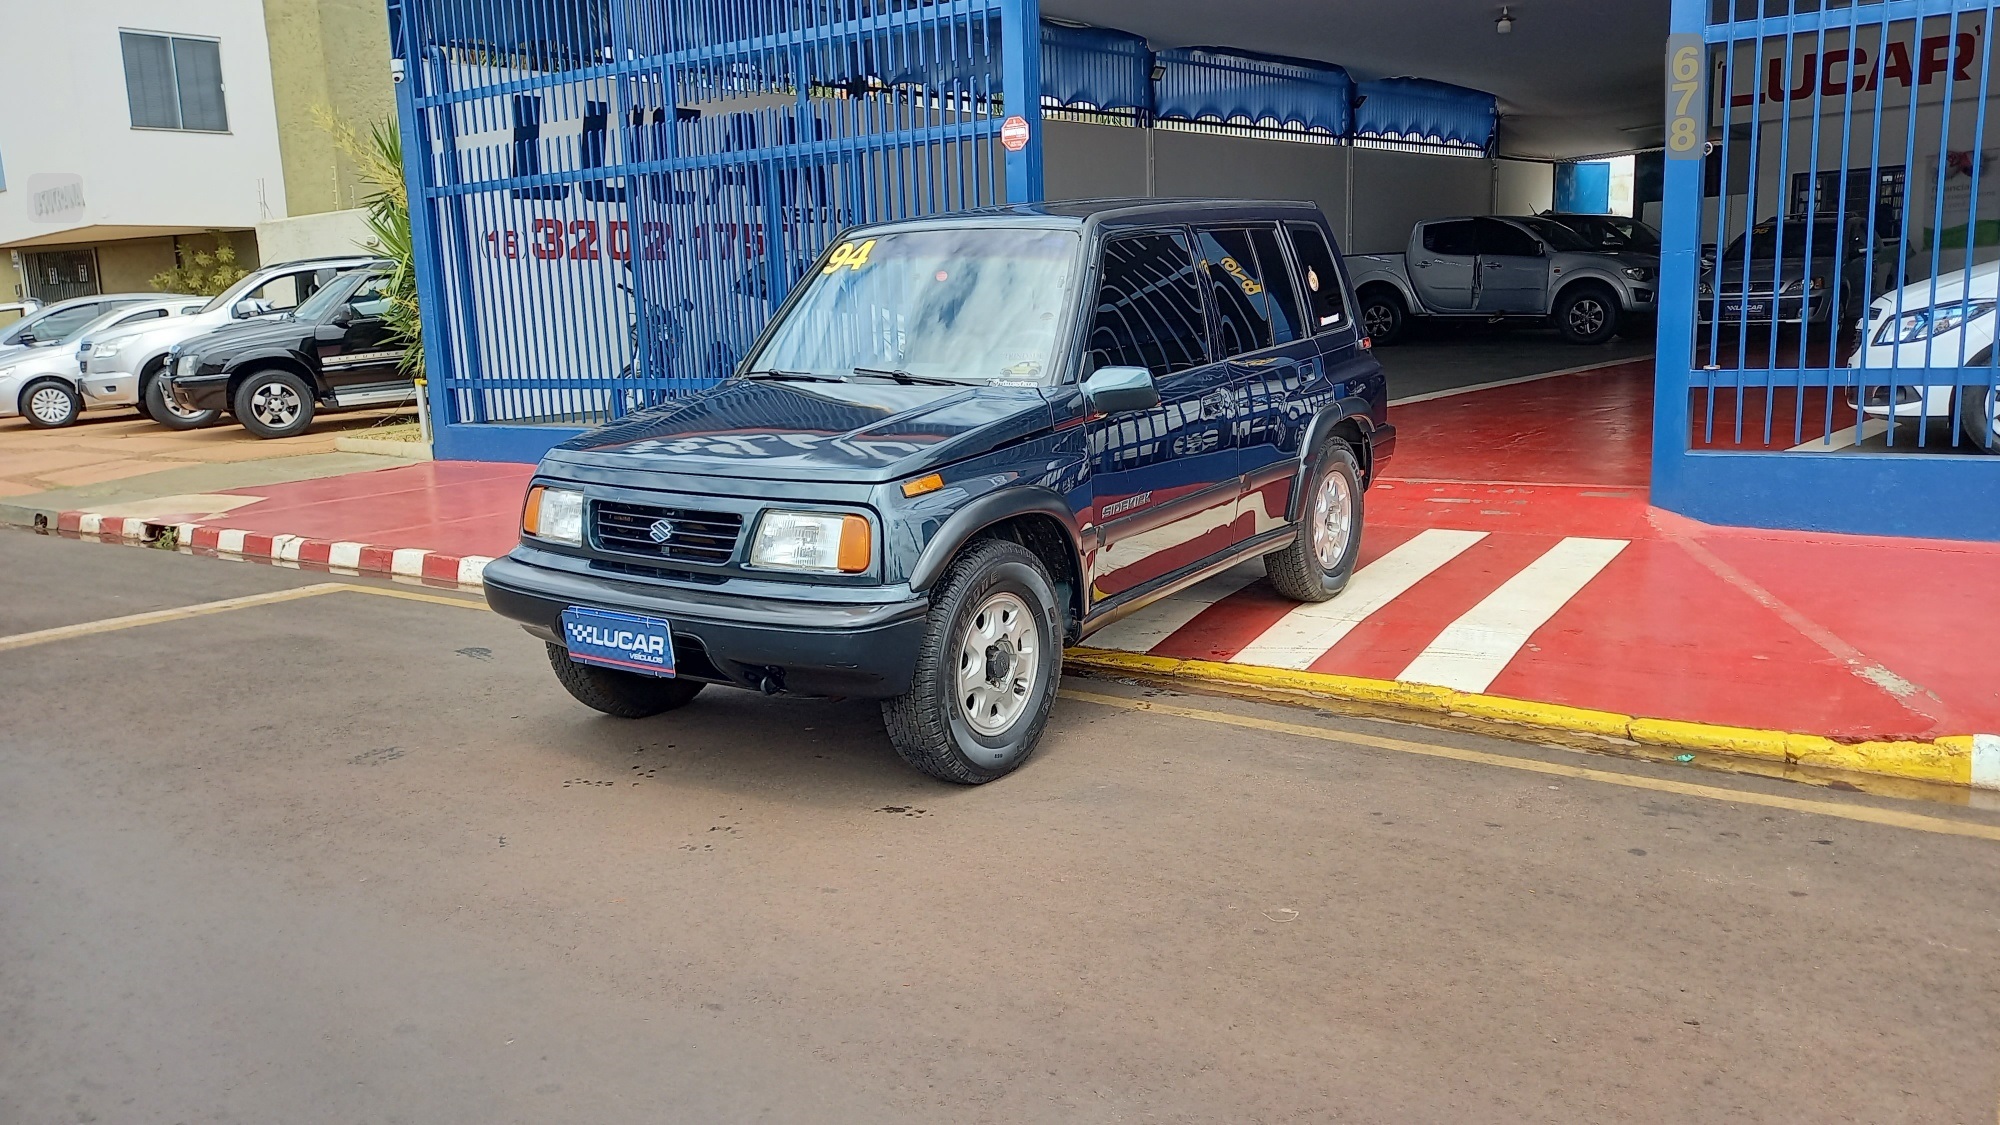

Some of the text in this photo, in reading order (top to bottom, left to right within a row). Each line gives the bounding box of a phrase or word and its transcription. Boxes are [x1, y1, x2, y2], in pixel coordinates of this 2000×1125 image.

[1669, 46, 1699, 152] 678
[781, 207, 853, 224] VECUOS
[822, 239, 877, 275] 94
[1102, 490, 1153, 519] SIDEKICK
[592, 627, 664, 655] LUCAR
